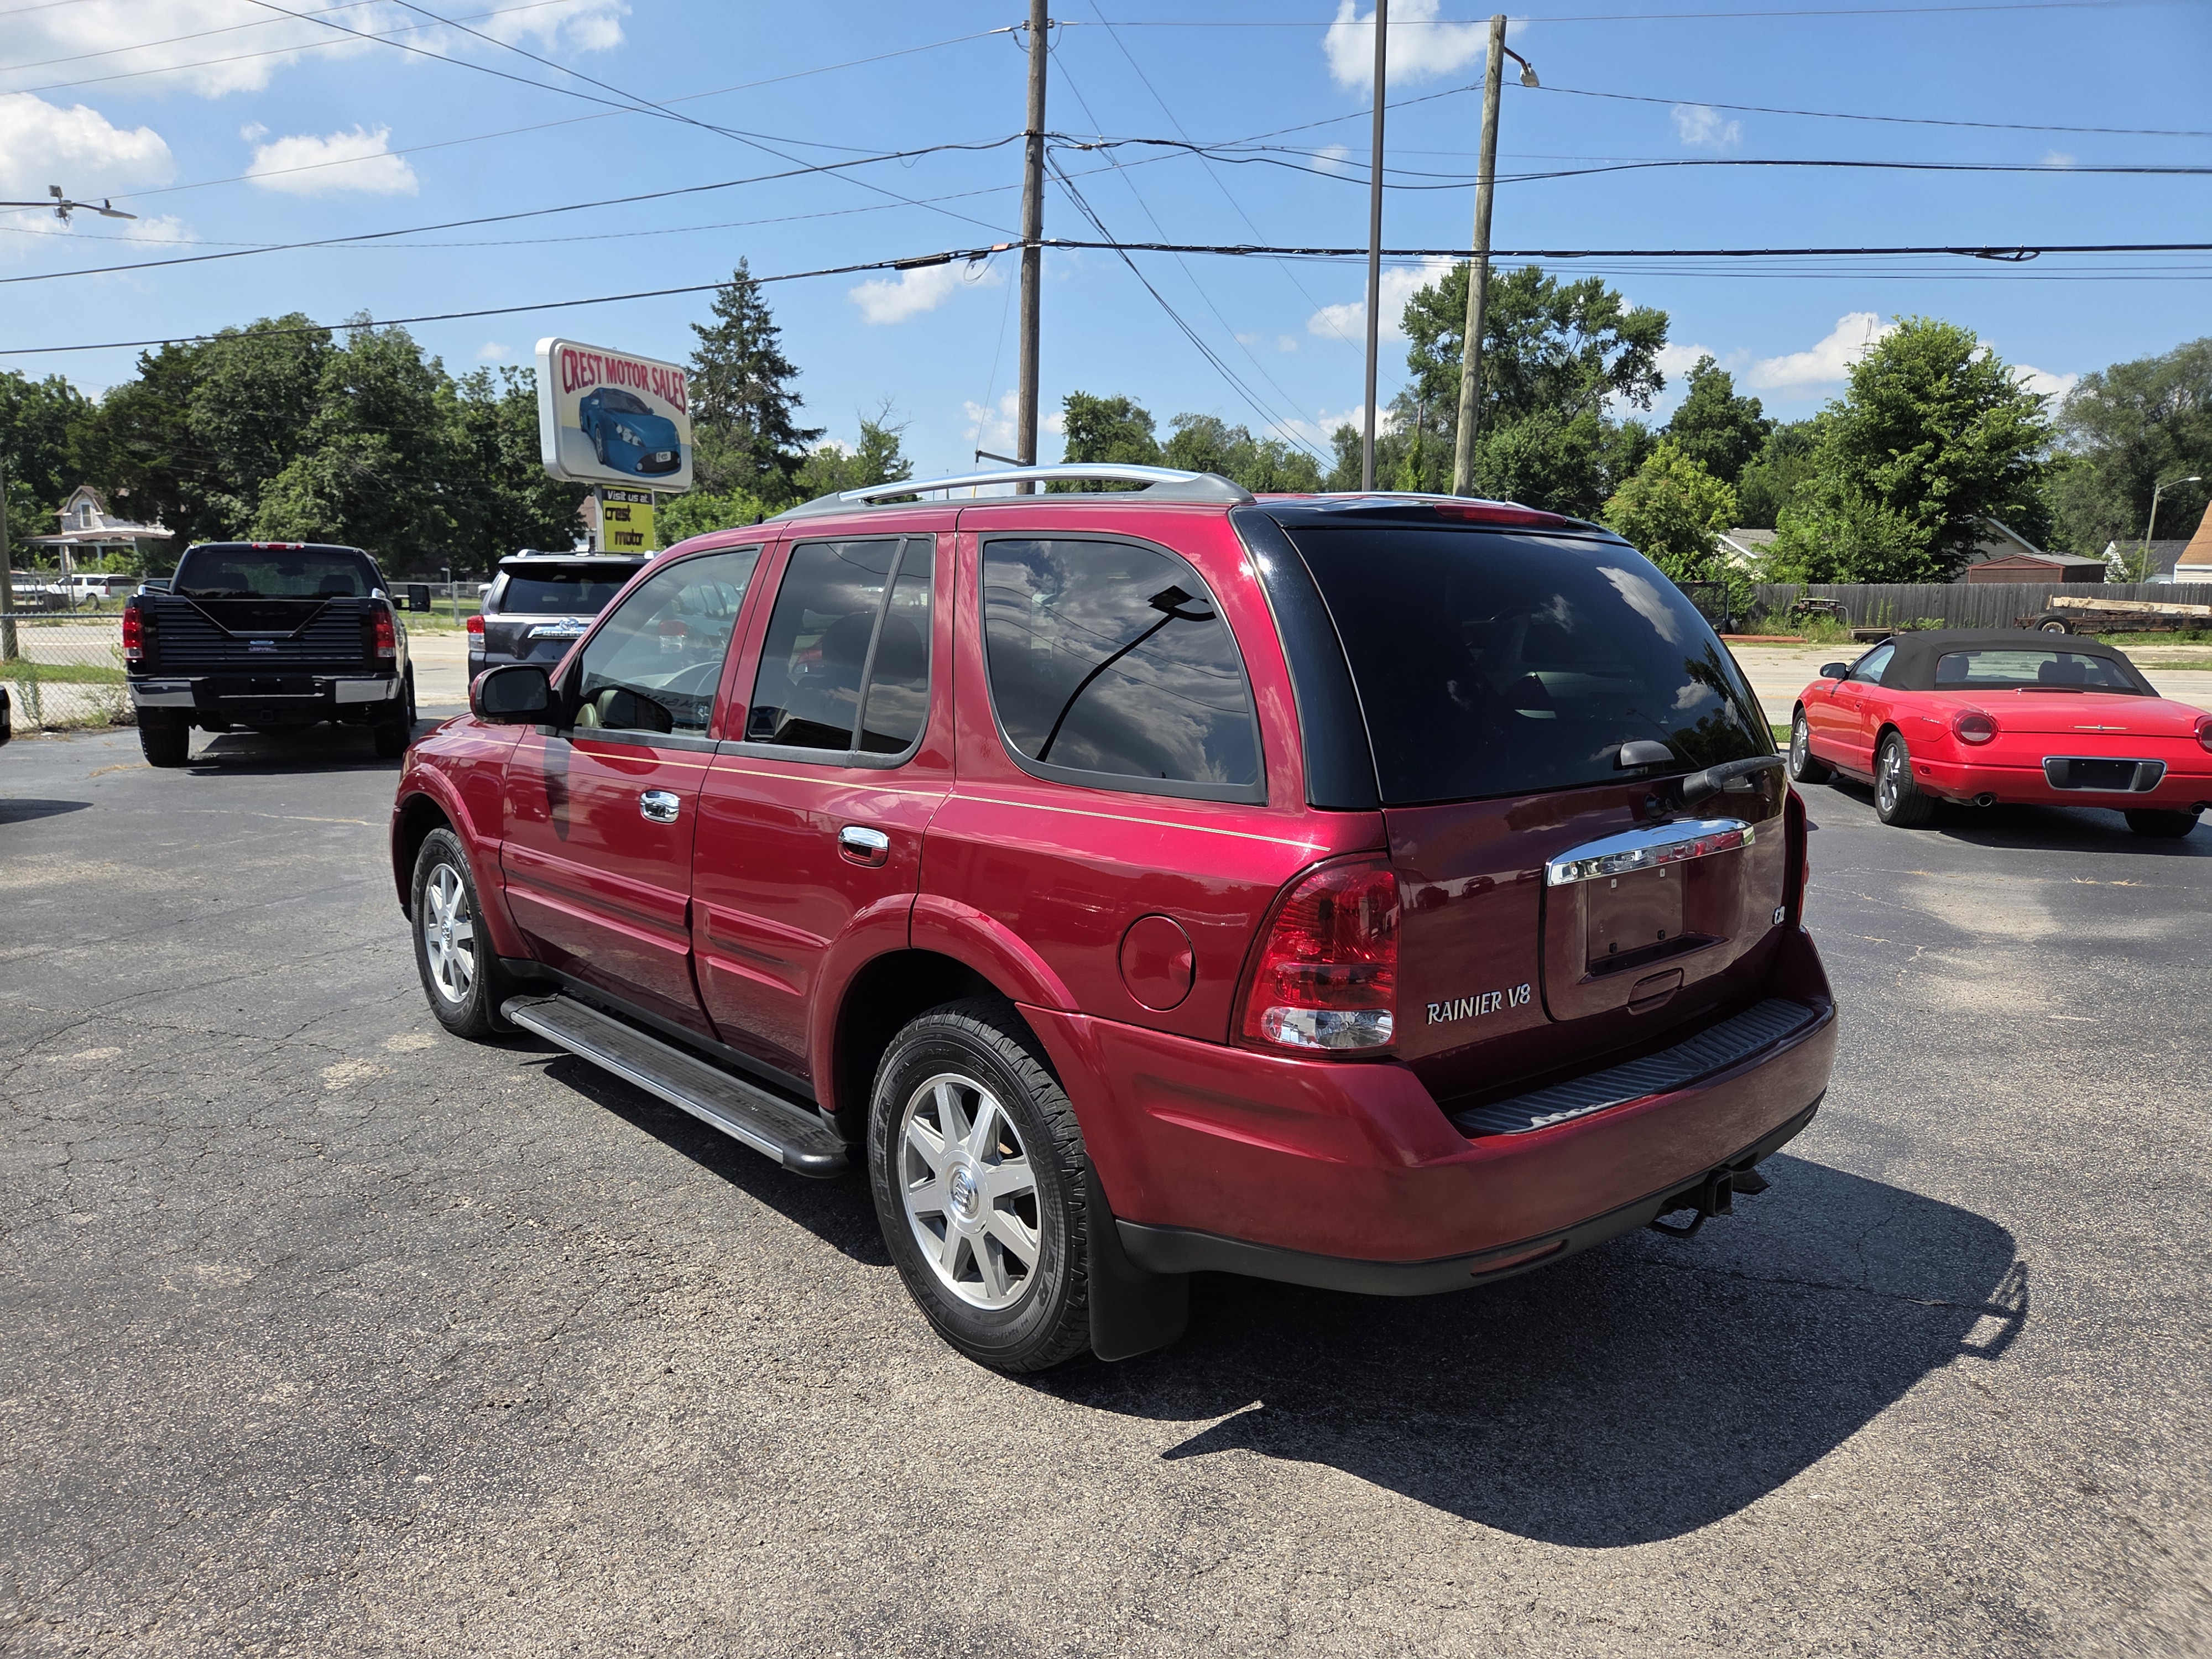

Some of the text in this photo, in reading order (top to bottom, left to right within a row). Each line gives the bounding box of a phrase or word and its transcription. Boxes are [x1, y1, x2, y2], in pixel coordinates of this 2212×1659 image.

[562, 348, 686, 415] CREST MOTOR SALES
[607, 490, 626, 501] Visit
[605, 504, 631, 522] crest
[615, 528, 644, 546] motor
[1627, 839, 1716, 864] UICK
[1427, 983, 1531, 1025] RAINIER V8
[966, 1055, 1058, 1307] GOODYEAR
